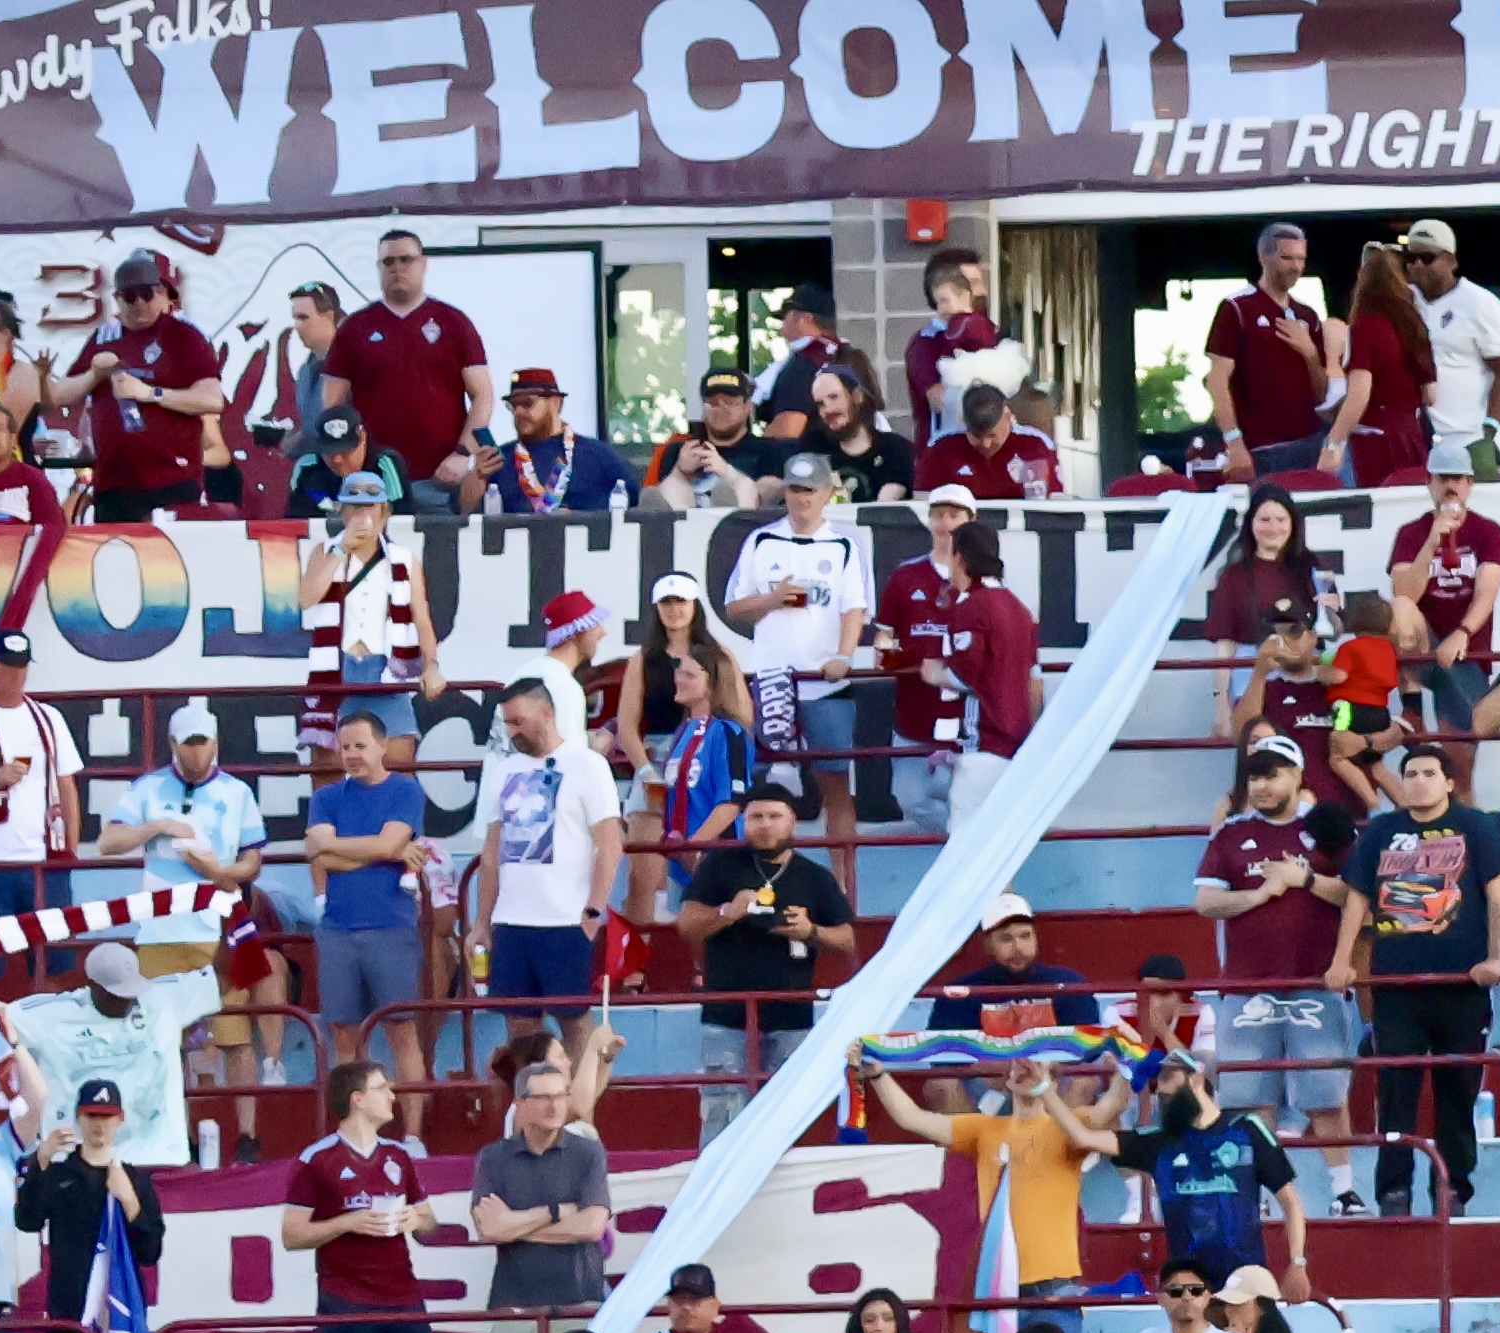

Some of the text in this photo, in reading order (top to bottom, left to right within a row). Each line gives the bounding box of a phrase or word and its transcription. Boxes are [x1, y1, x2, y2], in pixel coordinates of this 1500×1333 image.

[94, 0, 273, 68] Folks!
[90, 0, 1329, 213] WELCOME
[1130, 116, 1264, 177] THE
